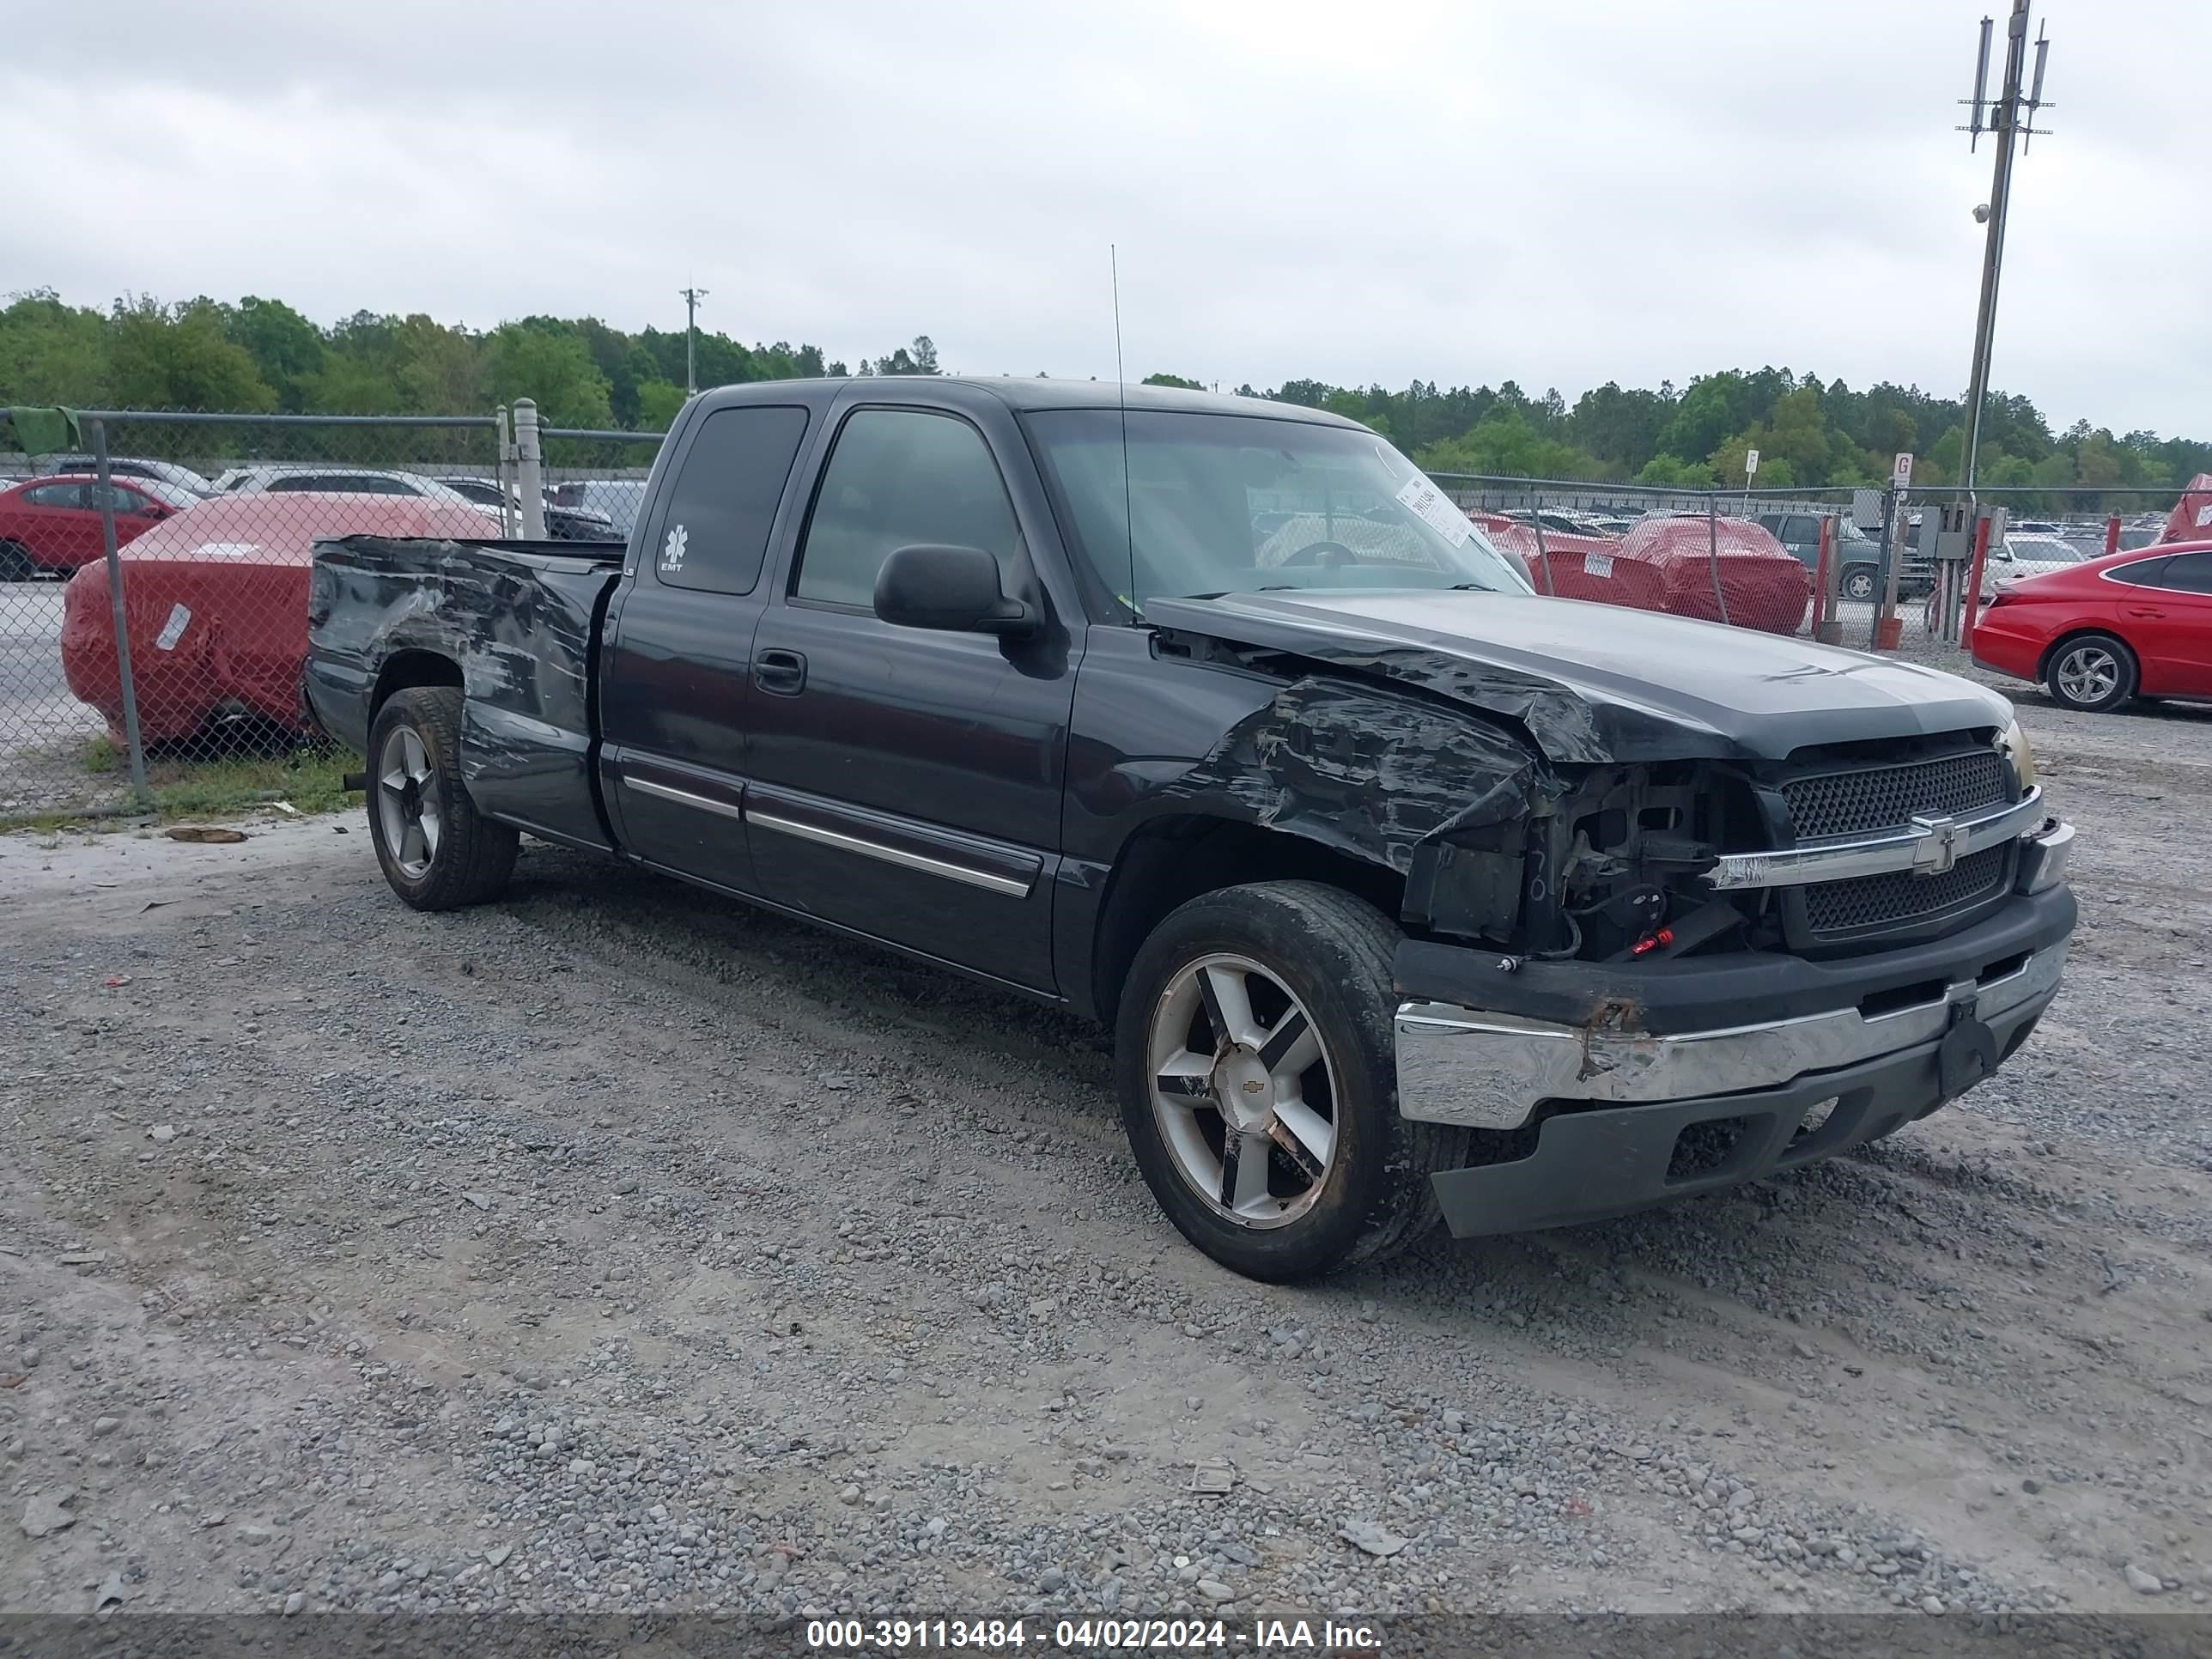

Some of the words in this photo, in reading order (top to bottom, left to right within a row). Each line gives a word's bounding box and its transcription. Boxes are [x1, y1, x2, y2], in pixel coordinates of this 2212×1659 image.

[1898, 456, 1909, 474] G
[623, 568, 635, 577] LS
[660, 562, 684, 573] EMT
